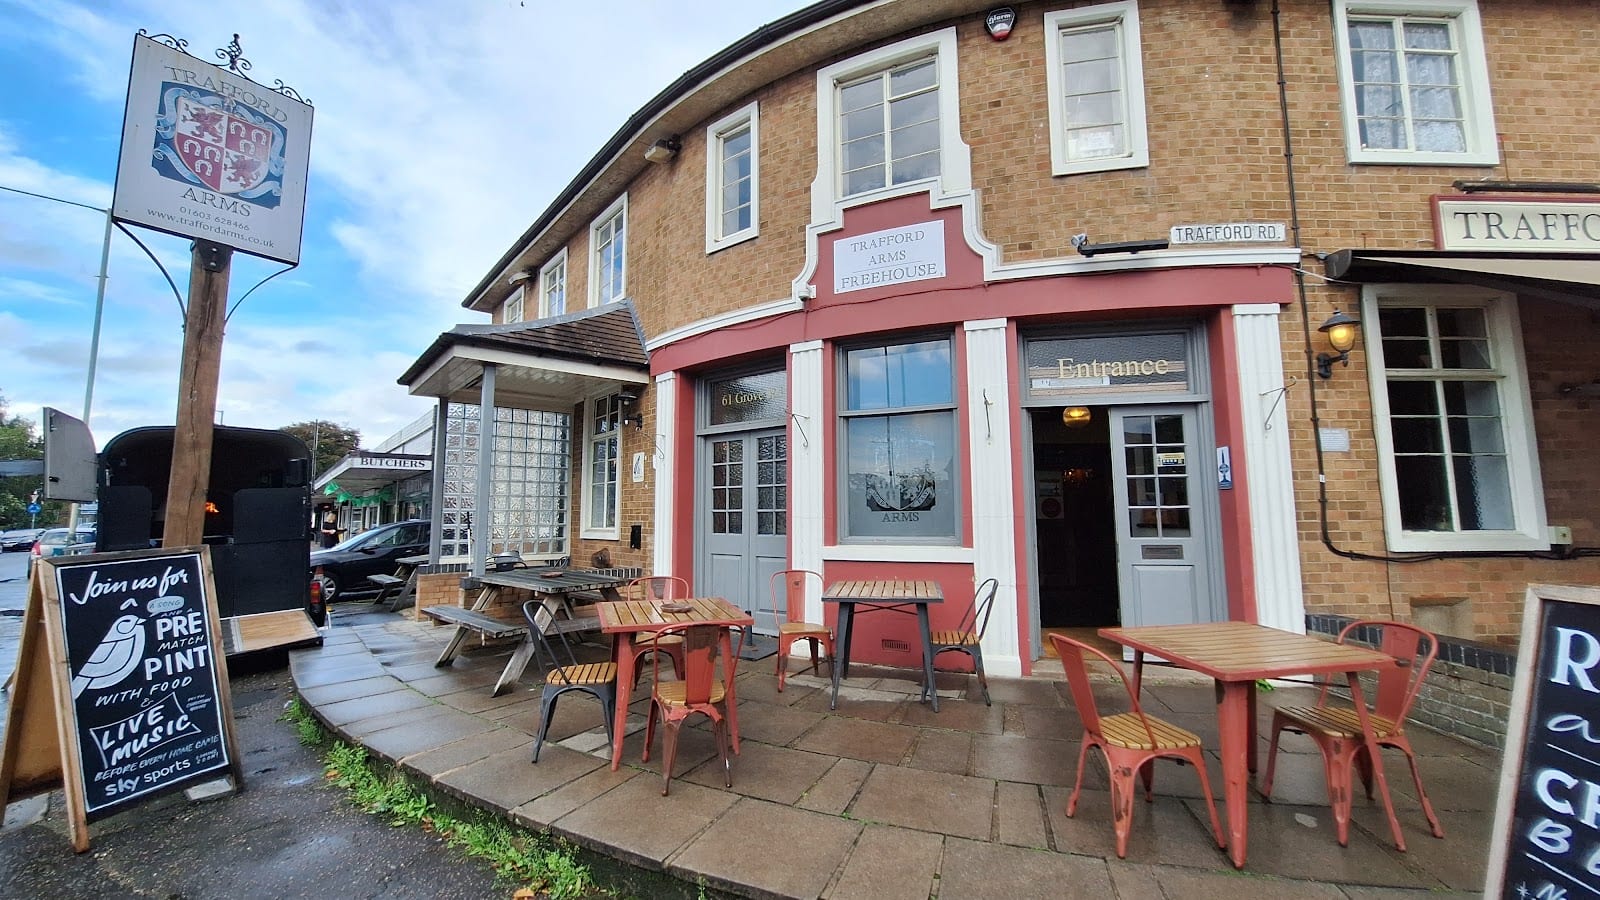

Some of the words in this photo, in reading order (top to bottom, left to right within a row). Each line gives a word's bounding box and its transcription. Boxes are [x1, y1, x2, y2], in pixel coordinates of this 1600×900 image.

[165, 66, 288, 123] TRAFFORD
[179, 187, 251, 217] ARMS
[147, 208, 274, 248] www.traffordarms.co.uk
[179, 206, 211, 220] 01603
[214, 216, 250, 231] 628466
[850, 230, 925, 252] TRAFFORD
[1175, 225, 1252, 241] TRAFFORD
[1258, 225, 1281, 240] RD.
[868, 249, 906, 266] ARMS
[841, 263, 938, 289] FREEHOUSE
[1056, 358, 1169, 379] Entrance
[721, 393, 732, 406] 61
[735, 391, 763, 404] Grove
[360, 457, 426, 468] BUTCHERS
[881, 512, 920, 523] ARMS
[69, 570, 128, 605] Join
[131, 576, 158, 591] us
[158, 566, 188, 597] for
[156, 611, 203, 641] PRE
[157, 634, 205, 652] MATCH
[144, 644, 208, 681] PINT
[95, 687, 143, 707] WITH
[149, 676, 193, 696] FOOD
[102, 704, 165, 751] LIVE
[111, 714, 191, 766] MUSIC
[94, 762, 138, 782] BEFORE
[194, 734, 219, 749] GAME
[143, 758, 191, 783] sports
